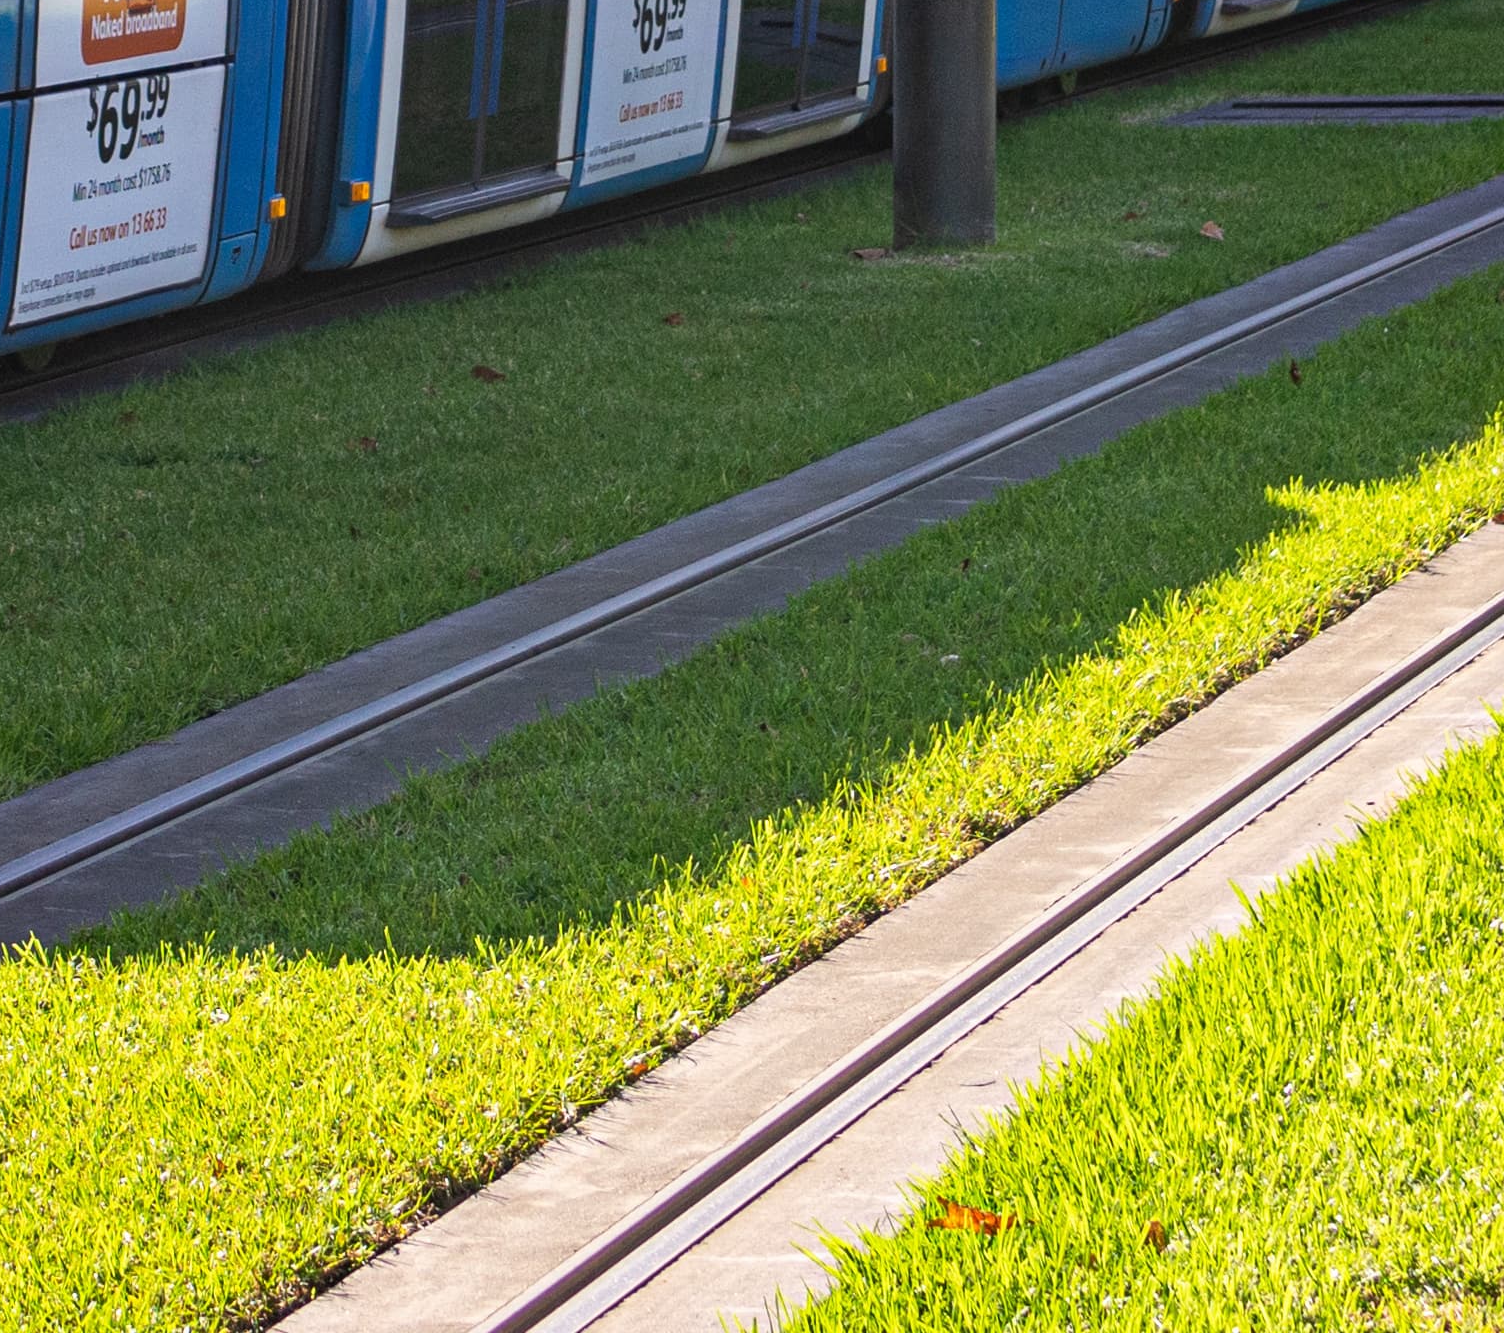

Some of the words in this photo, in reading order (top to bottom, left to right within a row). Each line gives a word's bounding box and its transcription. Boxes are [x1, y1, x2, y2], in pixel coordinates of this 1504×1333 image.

[91, 15, 123, 40] Naked
[127, 2, 178, 33] broadband
[86, 73, 170, 163] $69.99
[137, 126, 165, 149] /month
[70, 224, 87, 250] Call
[87, 229, 97, 246] us
[99, 224, 117, 244] now
[118, 221, 130, 239] on
[132, 212, 143, 235] 13
[143, 209, 155, 232] 66
[155, 206, 167, 230] 33
